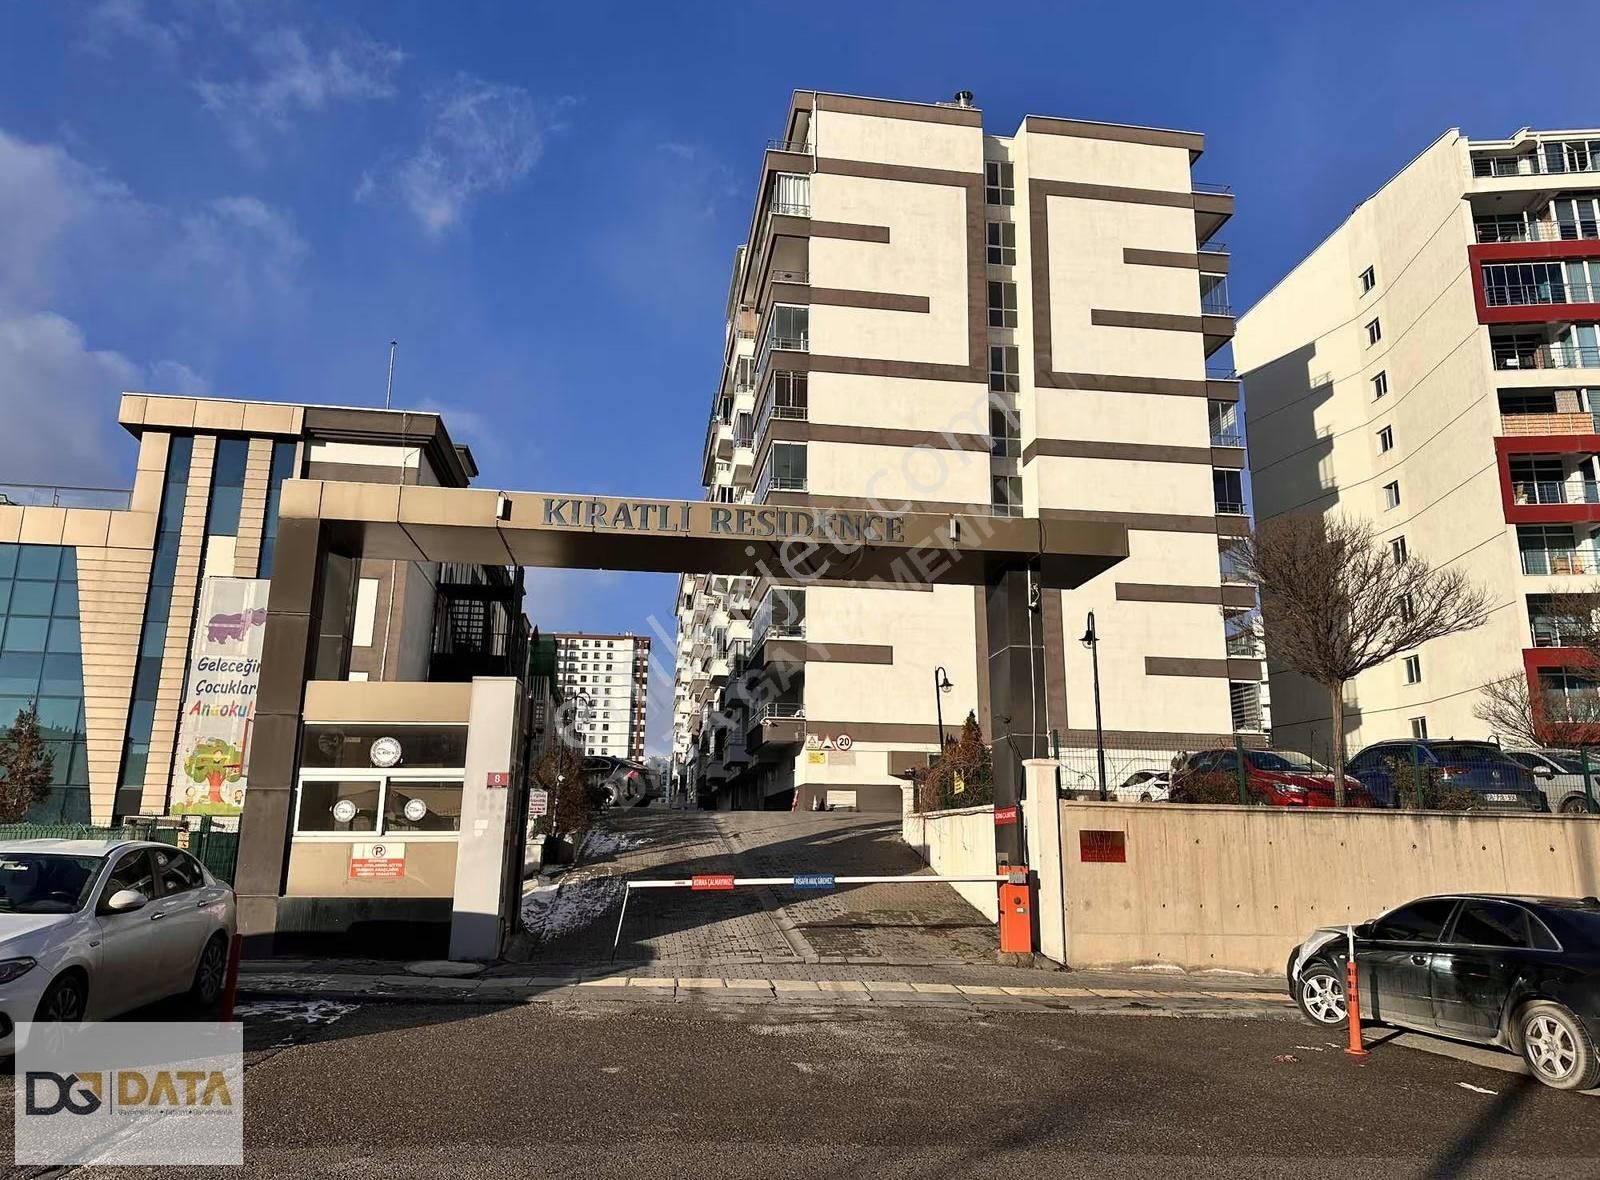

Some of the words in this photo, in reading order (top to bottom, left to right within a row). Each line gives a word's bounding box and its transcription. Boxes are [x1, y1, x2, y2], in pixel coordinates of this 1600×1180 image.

[709, 507, 905, 543] RESIDENCE
[195, 680, 257, 695] Çocuklar
[189, 700, 253, 717] Anaokul
[839, 738, 850, 746] 20
[494, 774, 501, 783] 8
